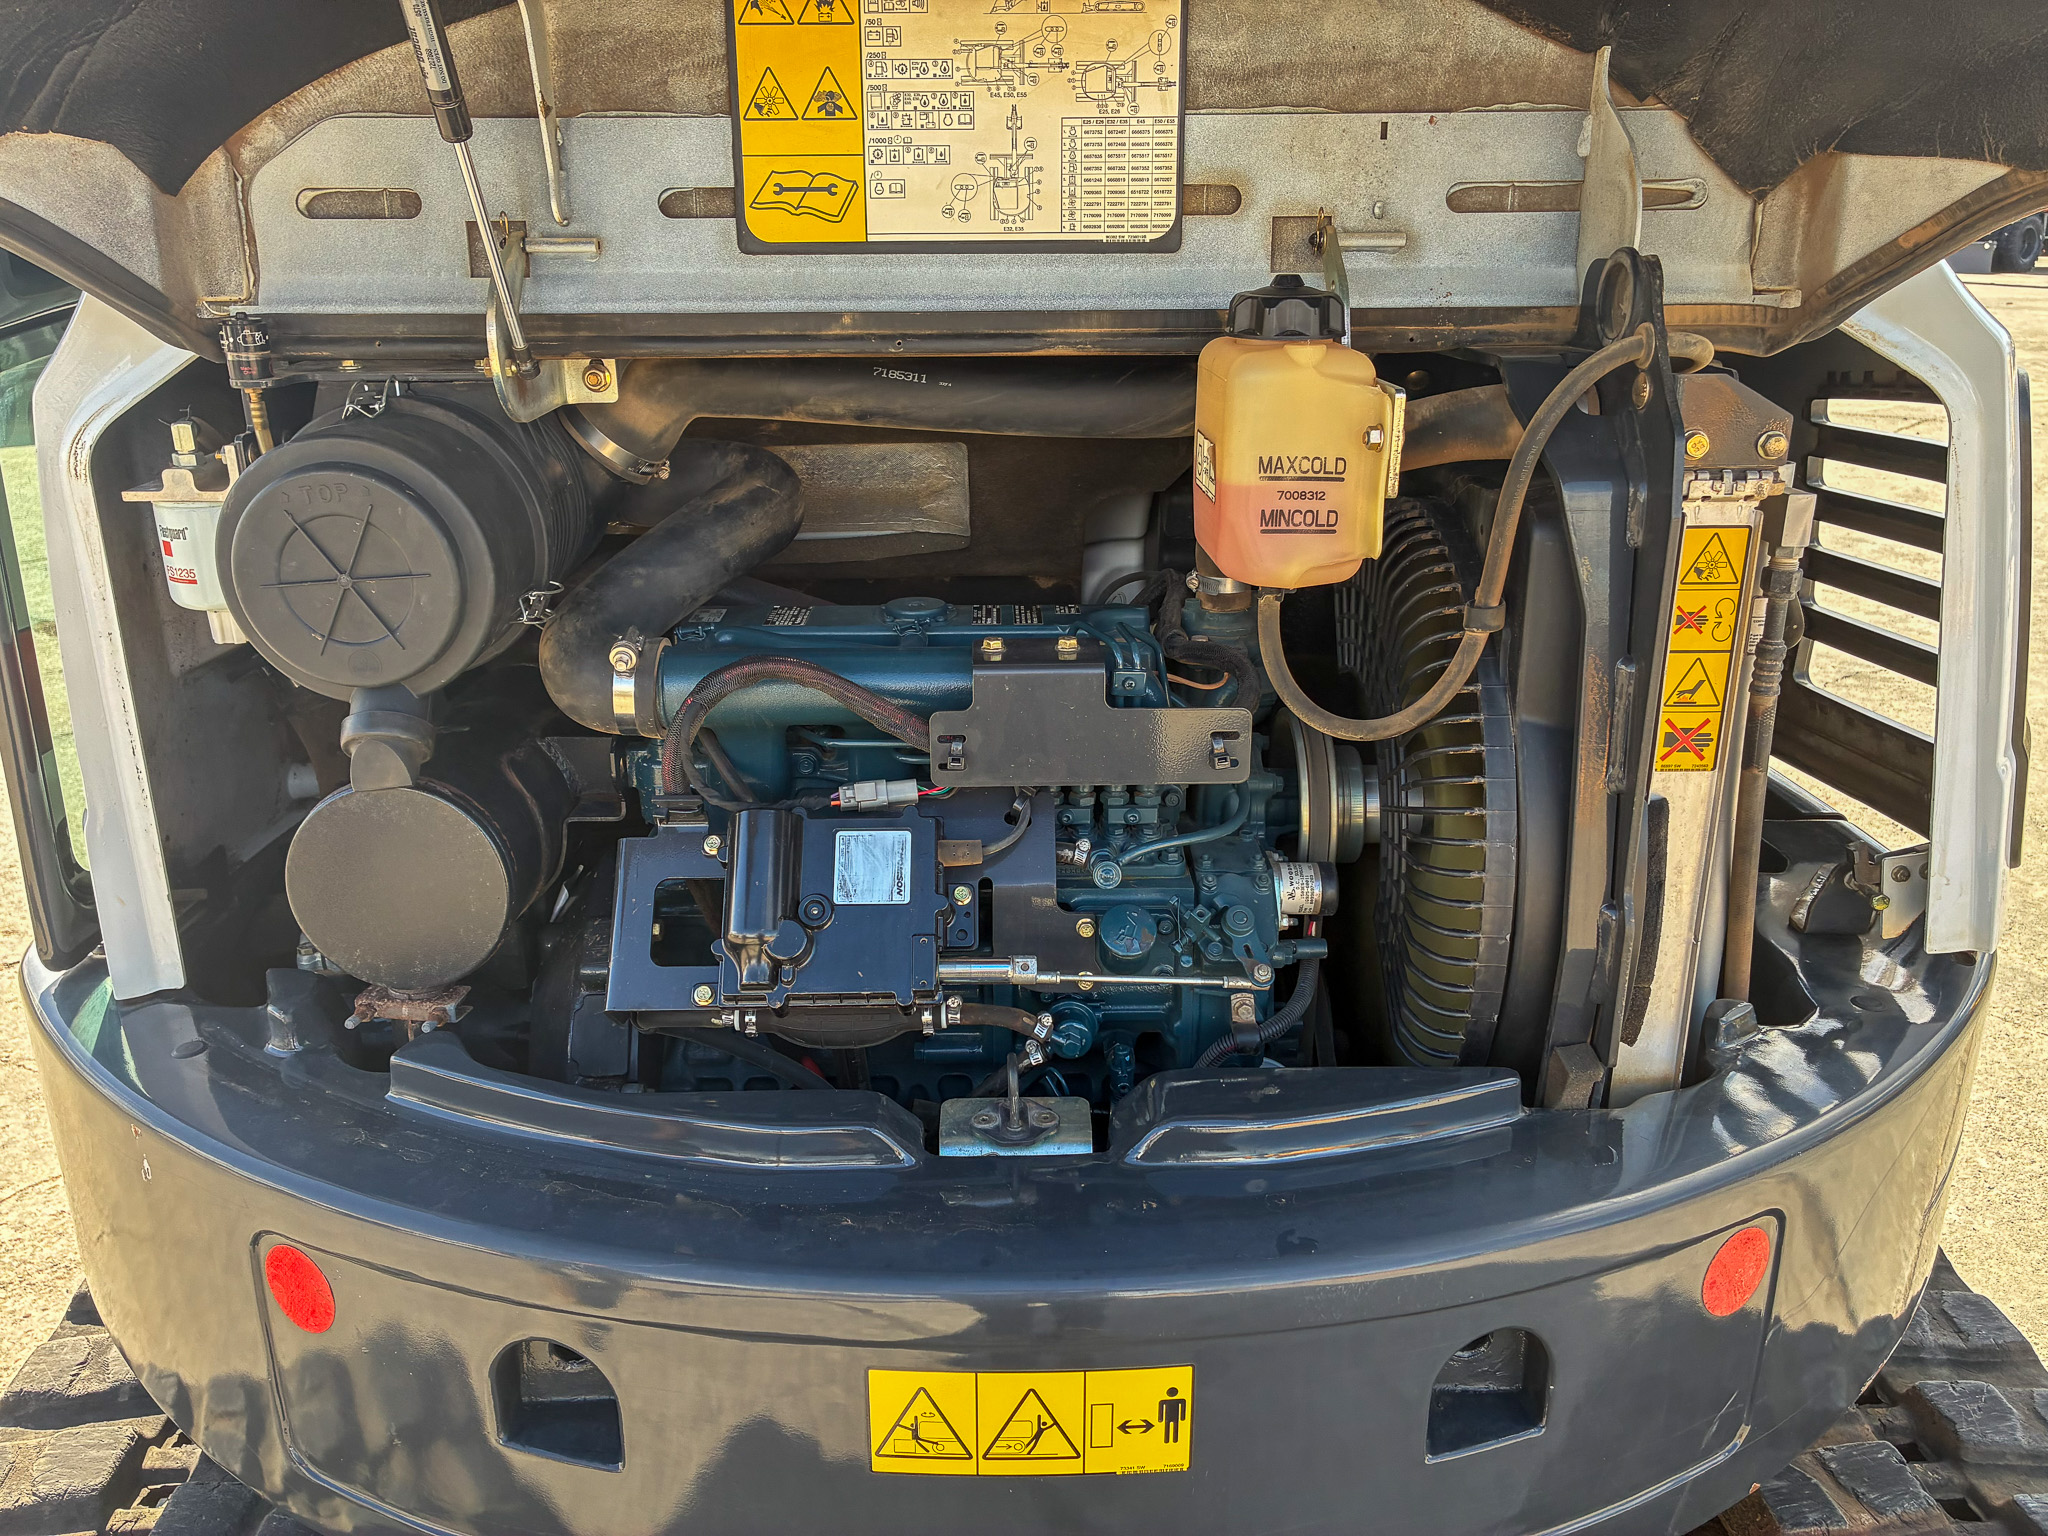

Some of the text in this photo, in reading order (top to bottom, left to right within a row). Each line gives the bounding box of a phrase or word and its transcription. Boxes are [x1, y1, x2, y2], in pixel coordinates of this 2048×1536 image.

[873, 367, 927, 383] 7185311
[1258, 456, 1346, 475] MAXCOLD
[298, 482, 348, 504] TOP
[1277, 491, 1326, 500] 7008312
[1260, 509, 1338, 528] MINCOLD
[167, 565, 196, 579] FS1235
